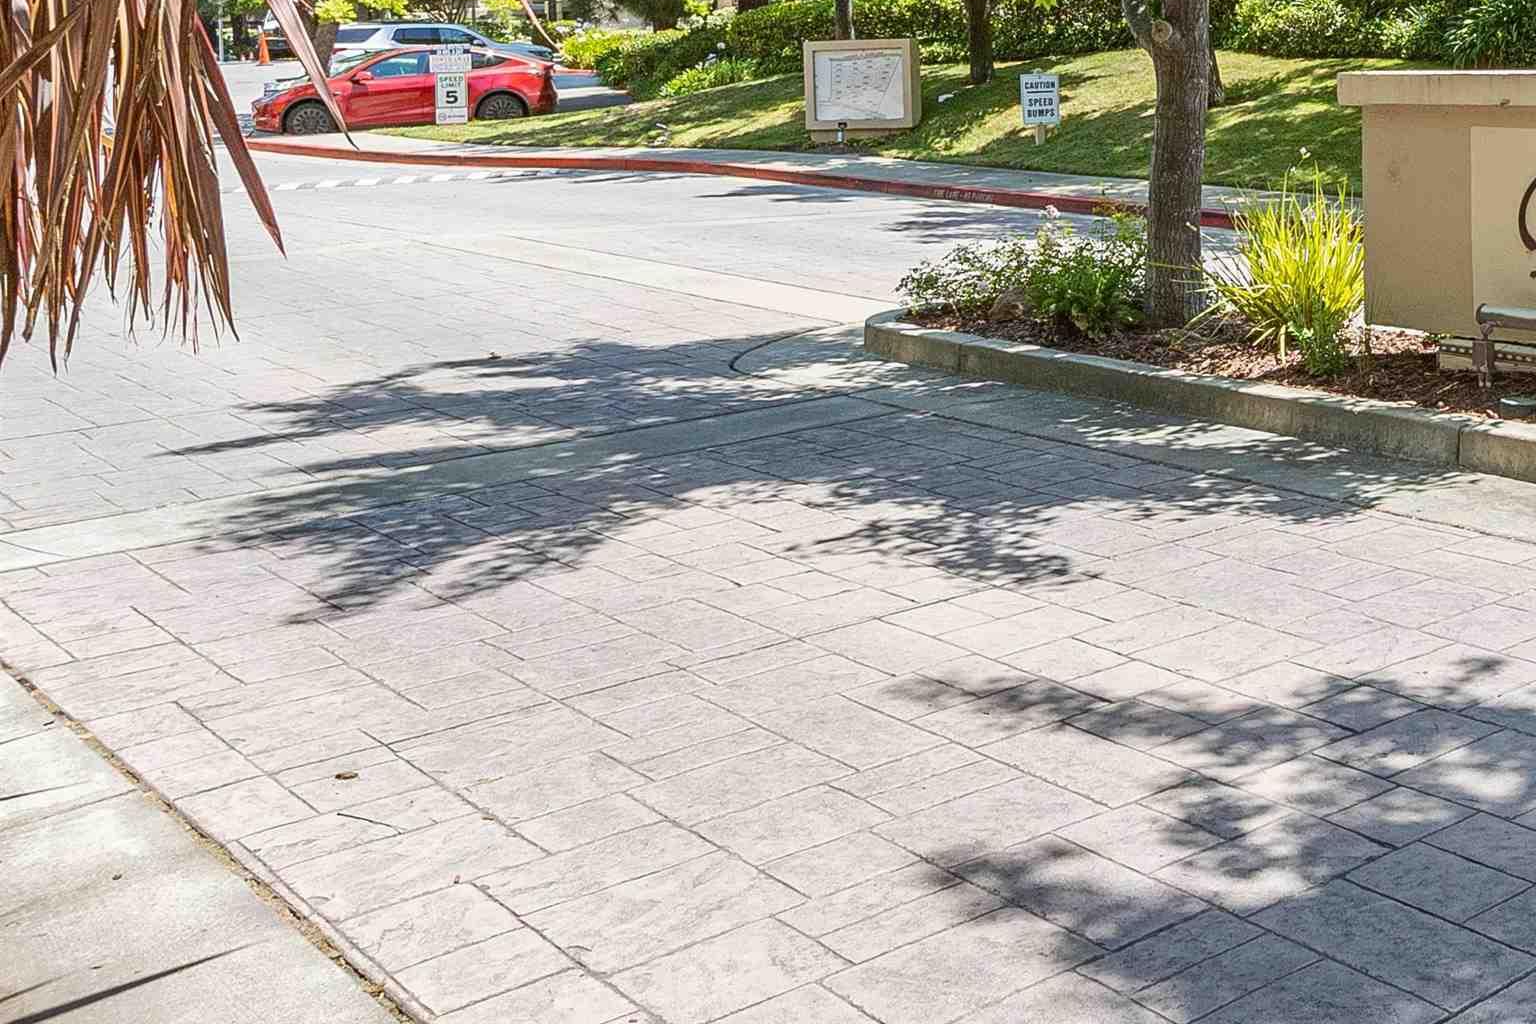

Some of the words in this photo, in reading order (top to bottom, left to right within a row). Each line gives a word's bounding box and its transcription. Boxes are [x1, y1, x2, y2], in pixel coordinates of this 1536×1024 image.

[1024, 80, 1056, 89] CAUTION
[445, 90, 459, 105] 5
[1028, 97, 1054, 107] SPEED
[1026, 109, 1056, 118] BUMPS
